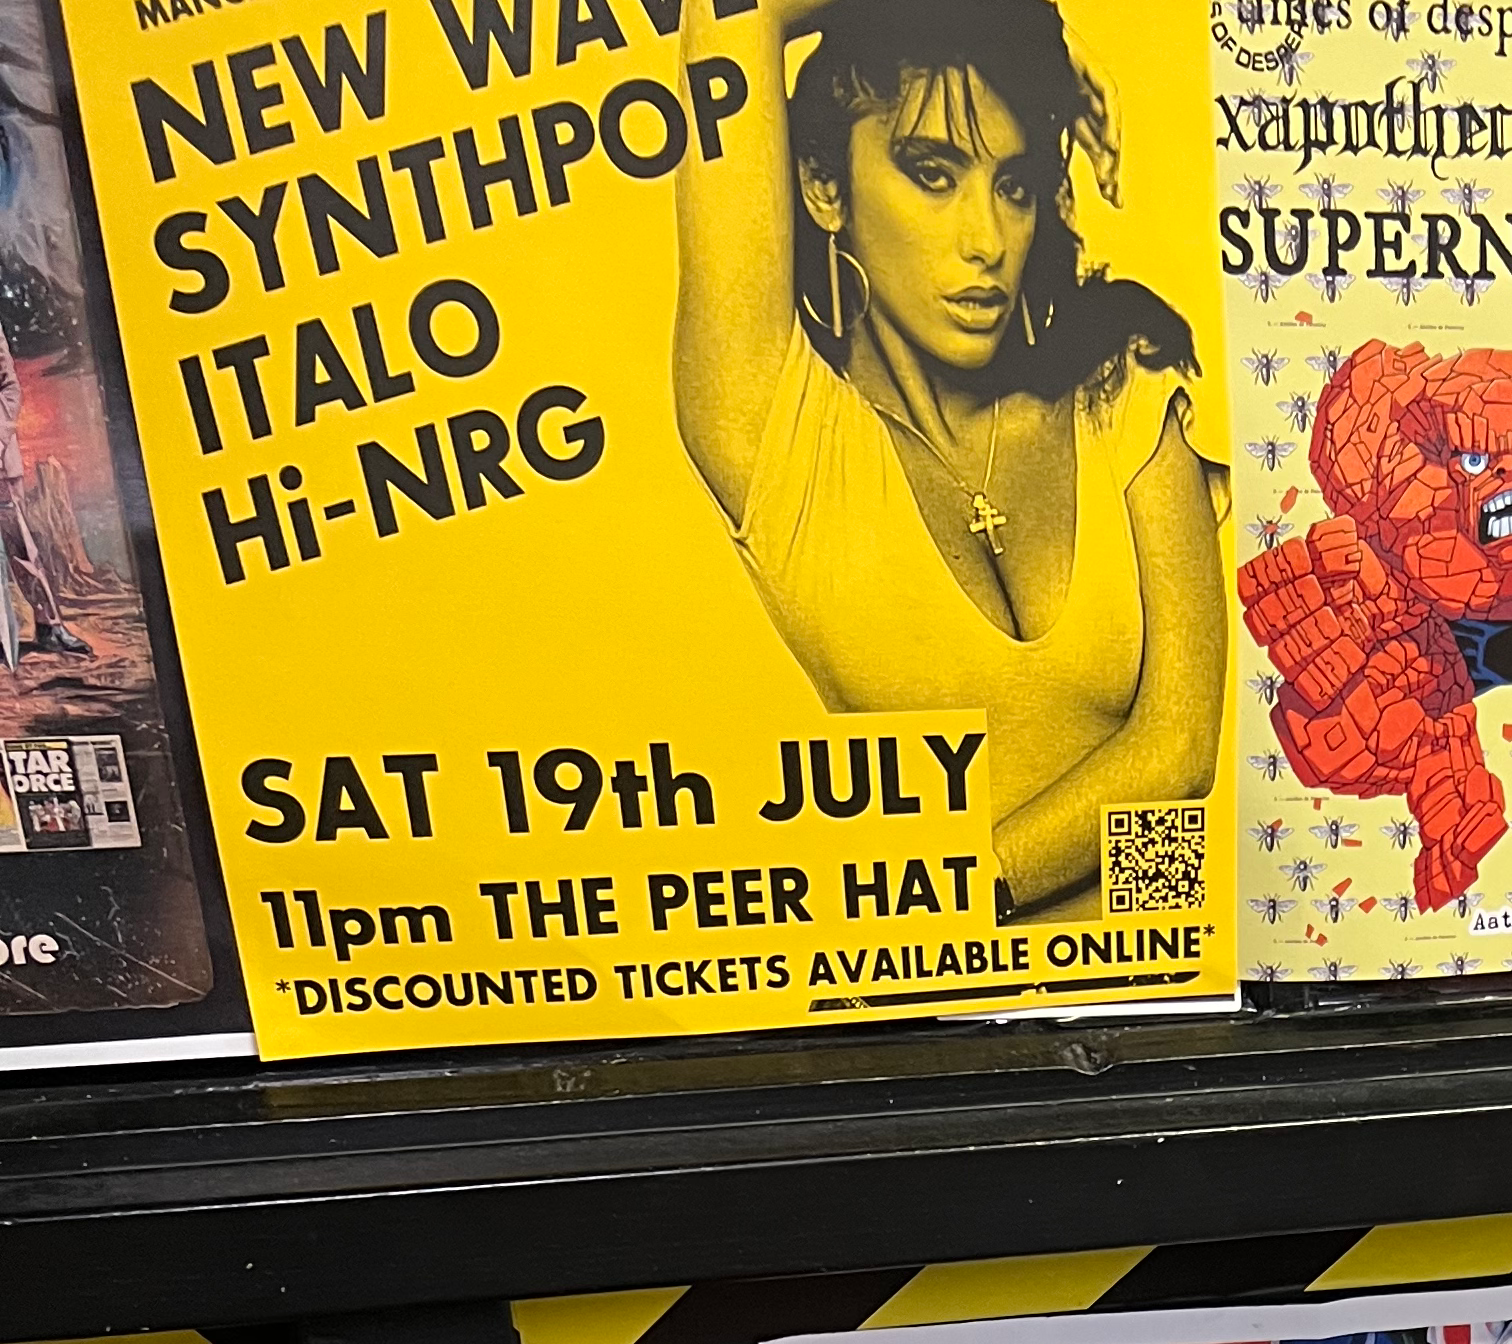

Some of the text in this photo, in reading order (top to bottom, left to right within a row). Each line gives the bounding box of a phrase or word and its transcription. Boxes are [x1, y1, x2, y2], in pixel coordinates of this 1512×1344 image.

[131, 11, 387, 183] NEW
[153, 55, 748, 314] SYNTHPOP
[179, 279, 500, 455] ITALO
[201, 385, 605, 585] Hi-NRG
[240, 732, 987, 844] SAT 19th JULY
[261, 855, 978, 962] 11pm THE PEER HAT
[614, 955, 789, 999] TICKETS
[809, 937, 1029, 987] AVAILABLE
